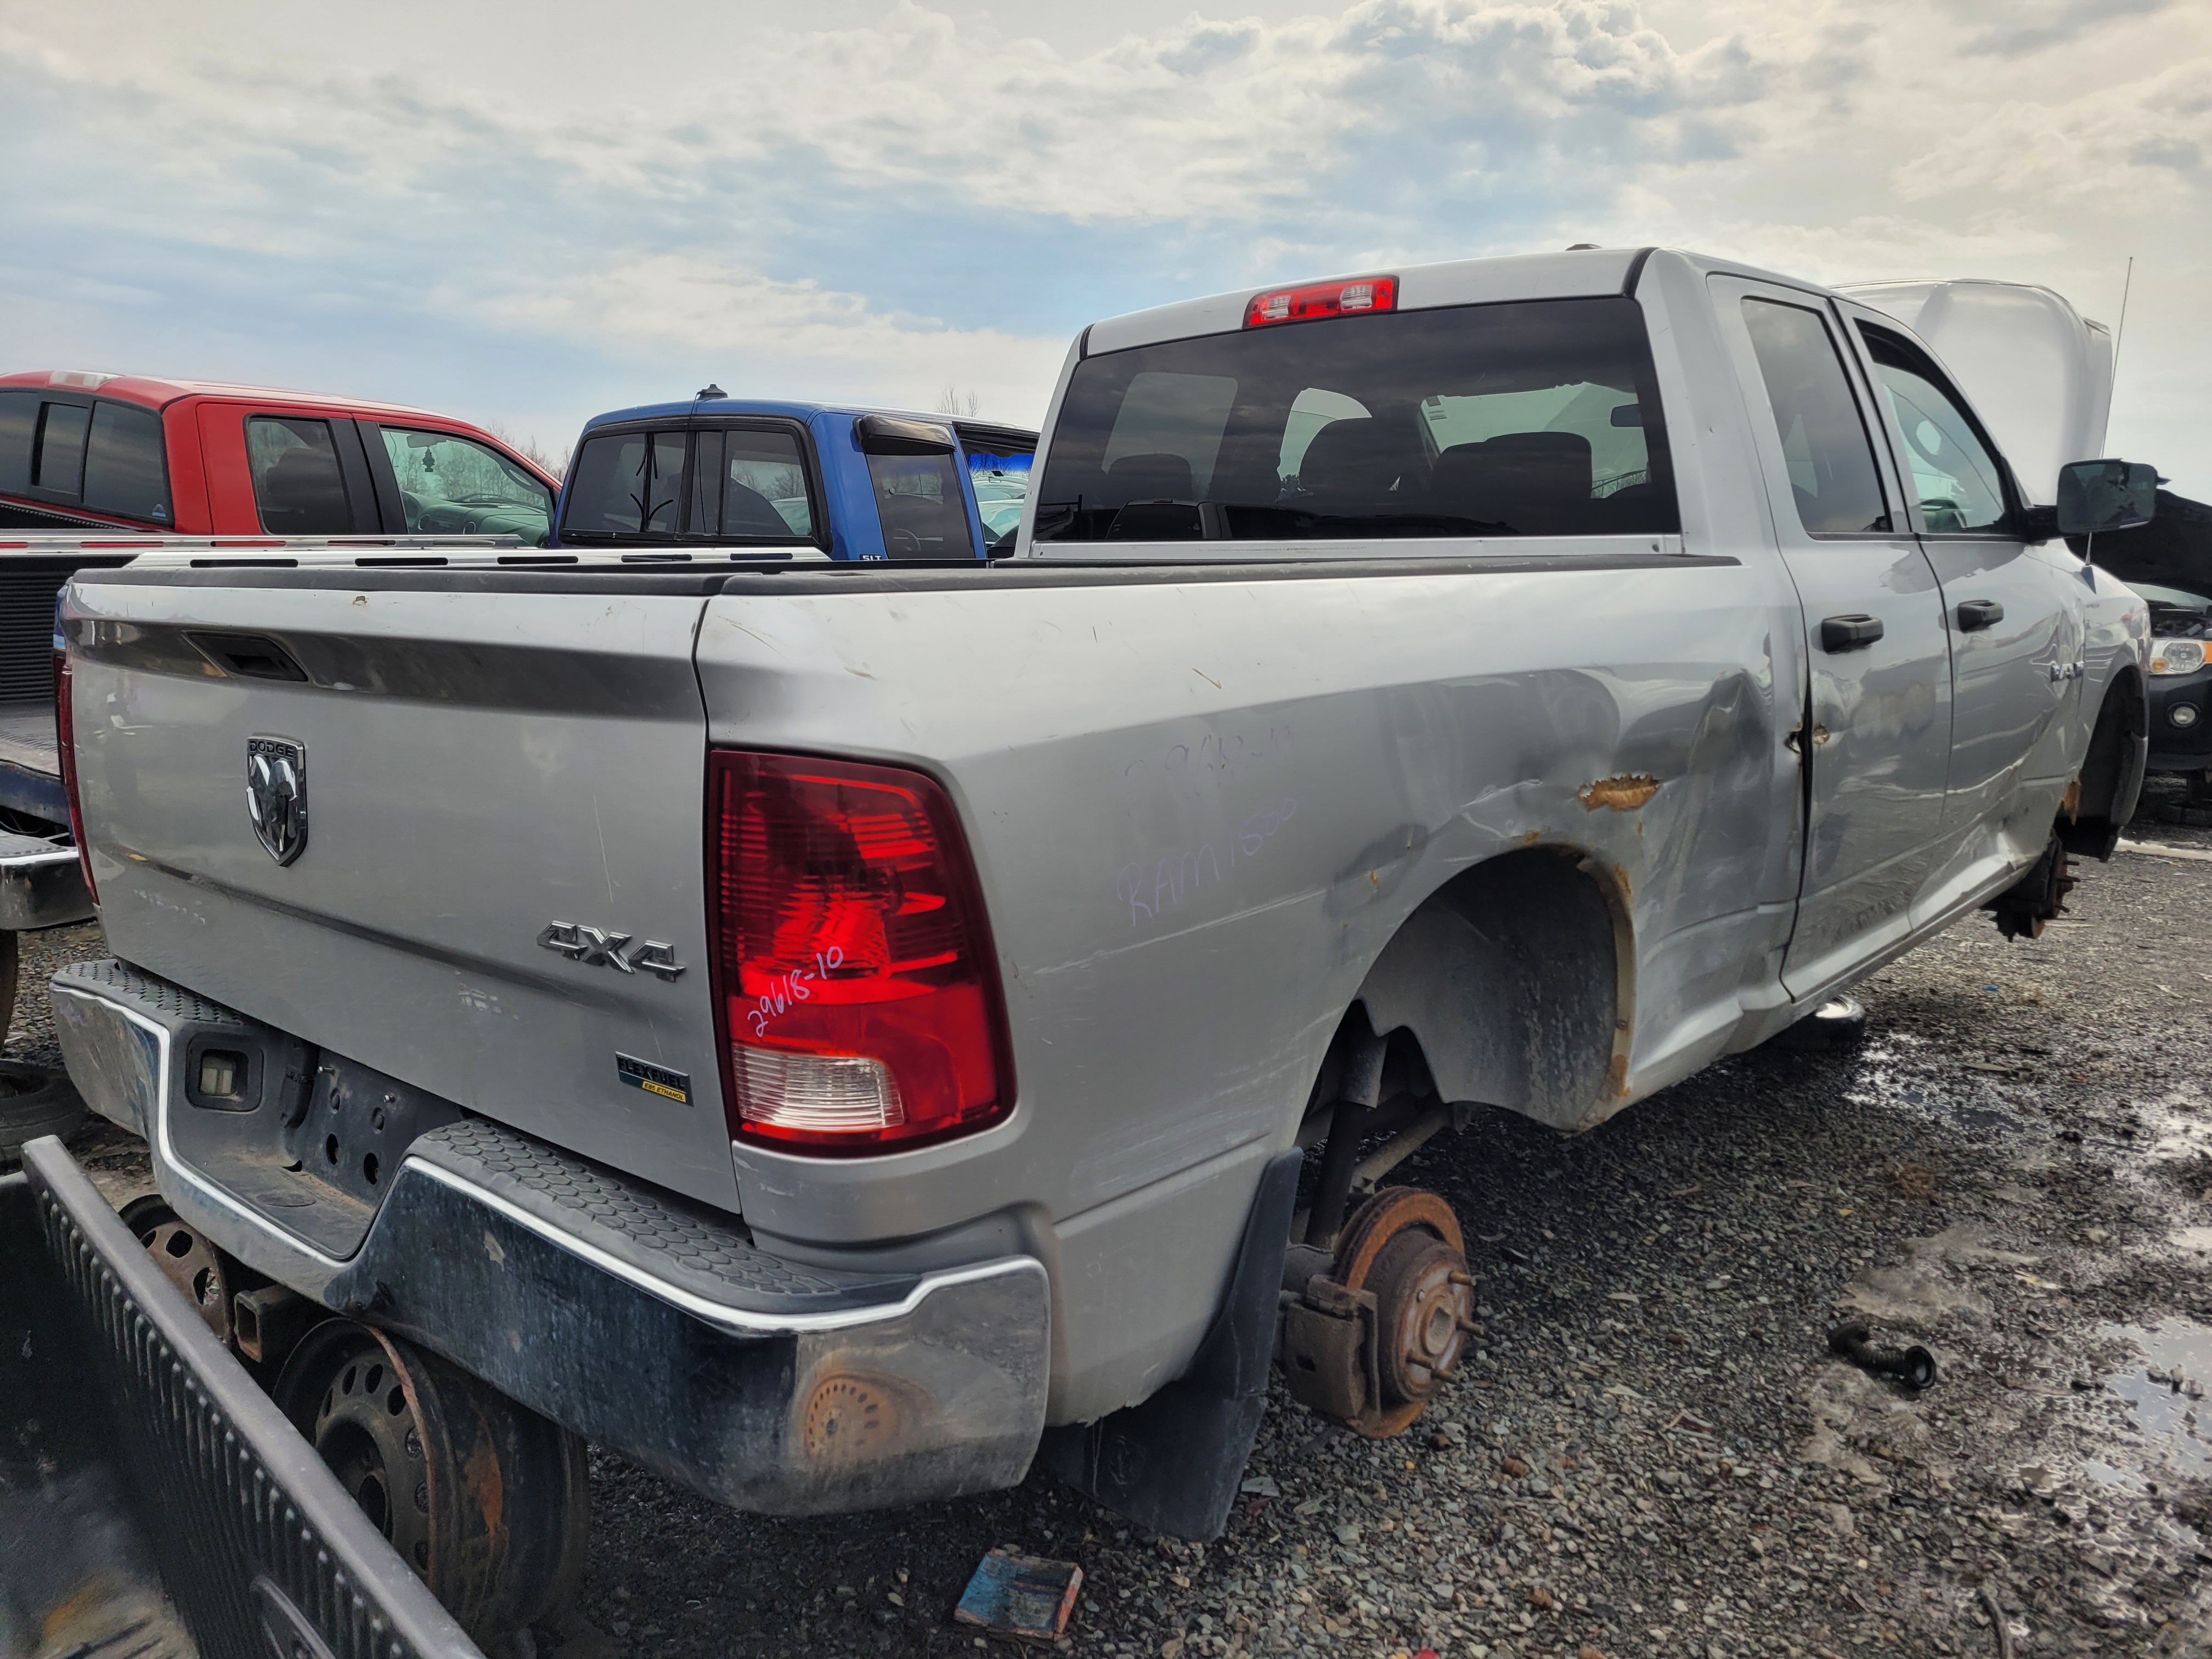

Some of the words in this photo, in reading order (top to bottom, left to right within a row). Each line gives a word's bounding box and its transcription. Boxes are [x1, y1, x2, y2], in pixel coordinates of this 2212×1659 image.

[250, 741, 294, 759] DODGE
[1117, 845, 1220, 927] RAM
[1229, 797, 1298, 868] 1500
[747, 946, 843, 1037] 29618-10
[657, 1087, 684, 1100] ETHANOL
